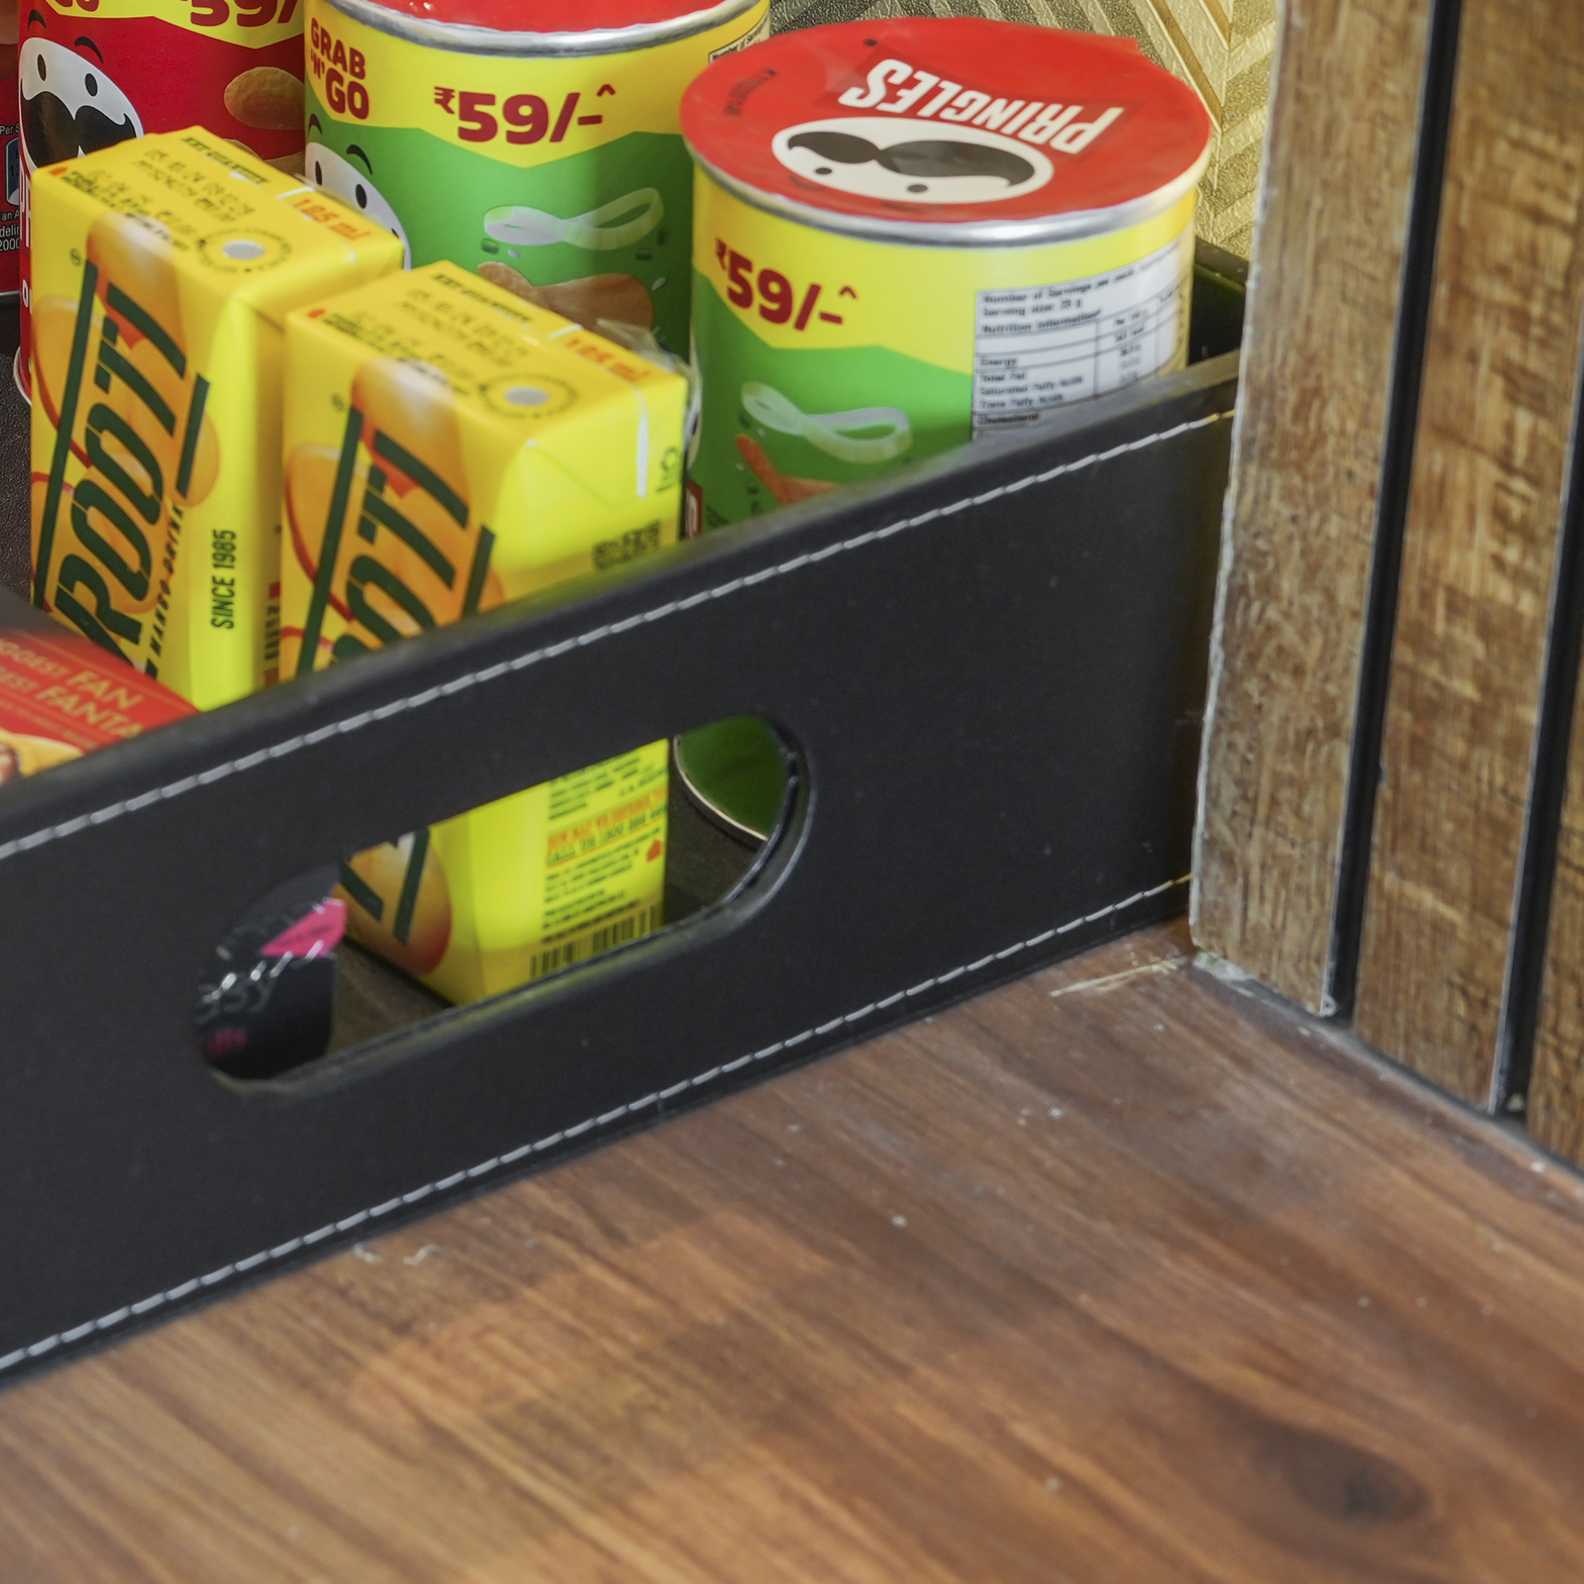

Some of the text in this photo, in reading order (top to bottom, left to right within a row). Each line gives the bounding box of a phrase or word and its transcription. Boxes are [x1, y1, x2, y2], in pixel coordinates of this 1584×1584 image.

[309, 16, 367, 81] GRAB
[324, 71, 370, 122] GO
[838, 57, 1127, 156] PRINGLES
[0, 124, 13, 136] Per
[1, 211, 13, 222] an
[54, 282, 187, 670] ROOTI
[211, 528, 237, 630] SINCE 1985
[66, 670, 145, 711] FAN
